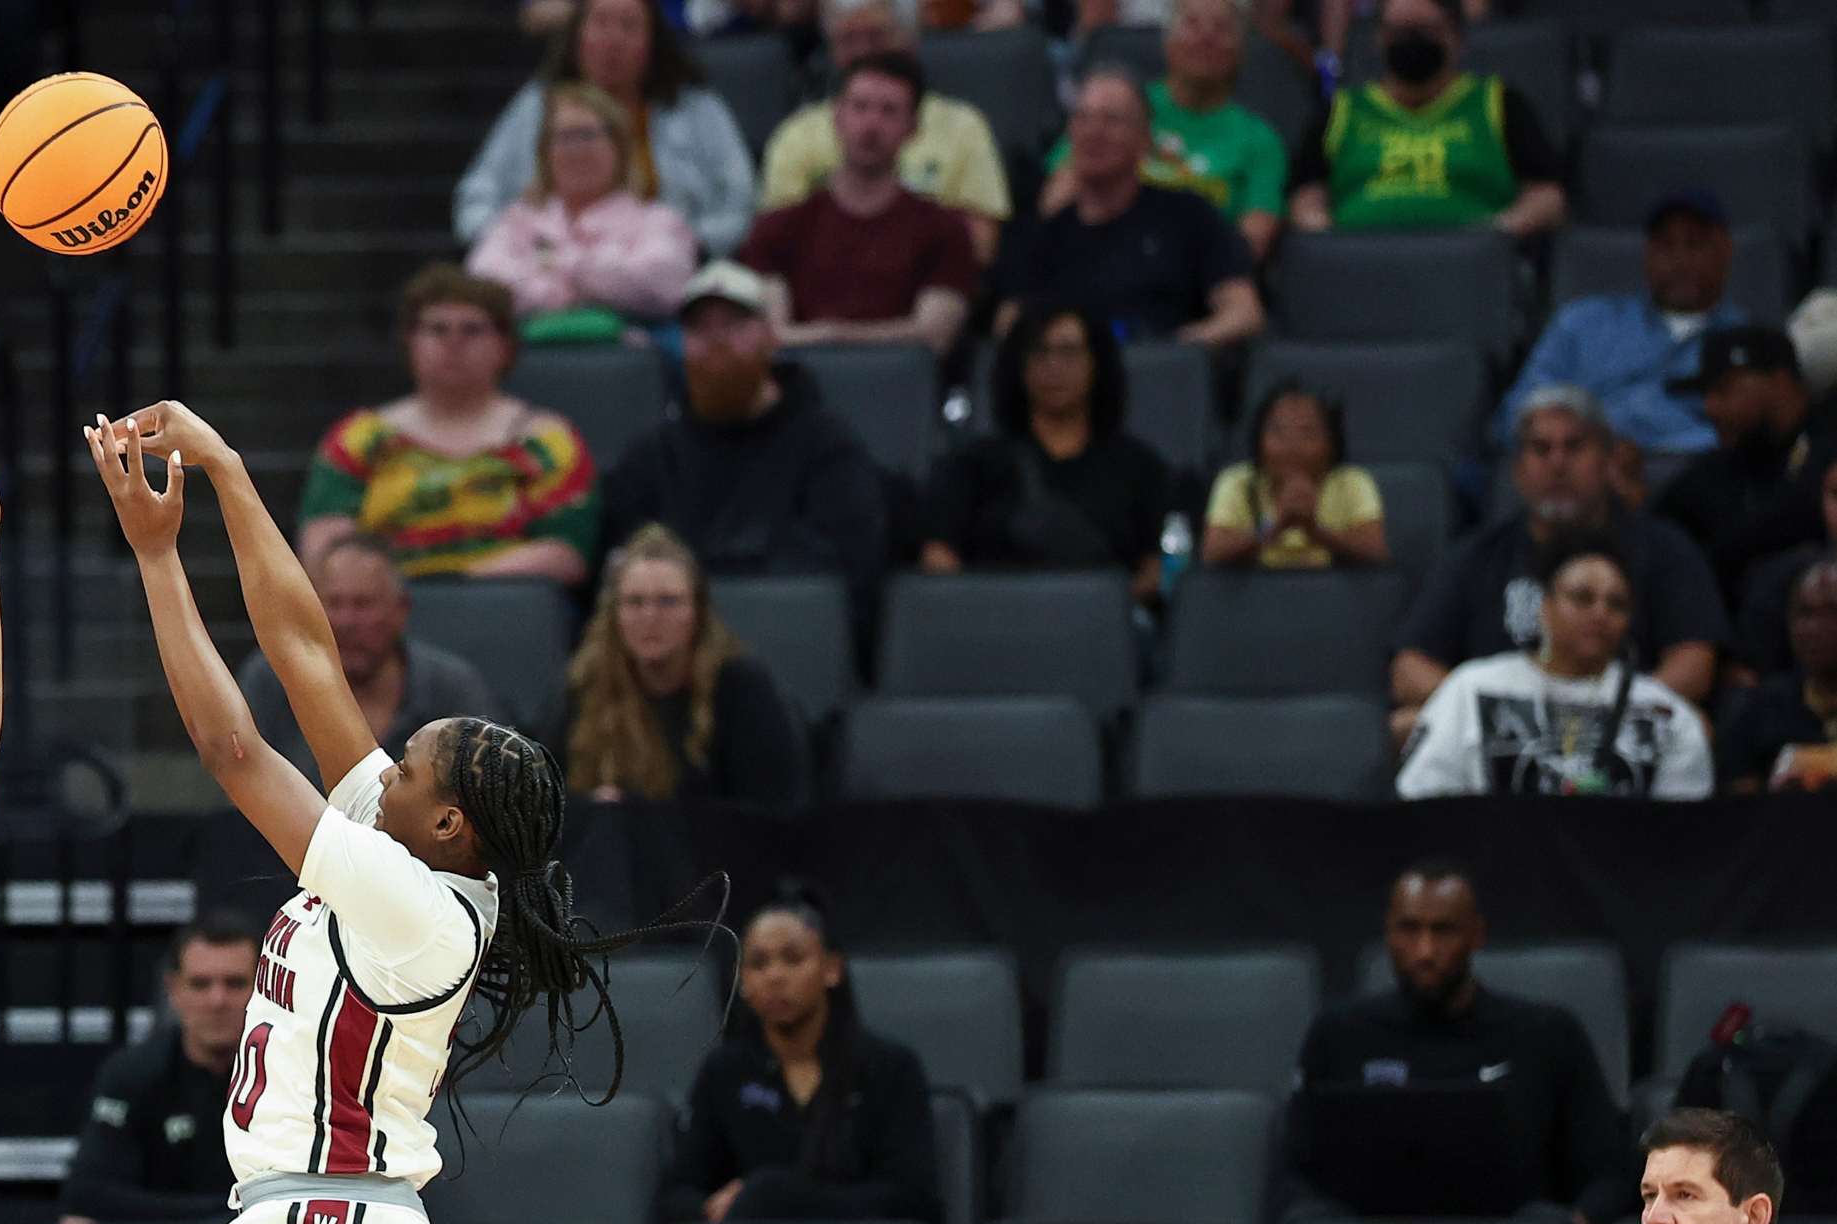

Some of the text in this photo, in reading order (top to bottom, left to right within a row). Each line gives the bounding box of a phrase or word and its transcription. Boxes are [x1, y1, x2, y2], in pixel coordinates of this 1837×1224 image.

[50, 170, 156, 247] Wilson
[257, 953, 296, 1013] OLINA
[227, 1021, 274, 1132] 0
